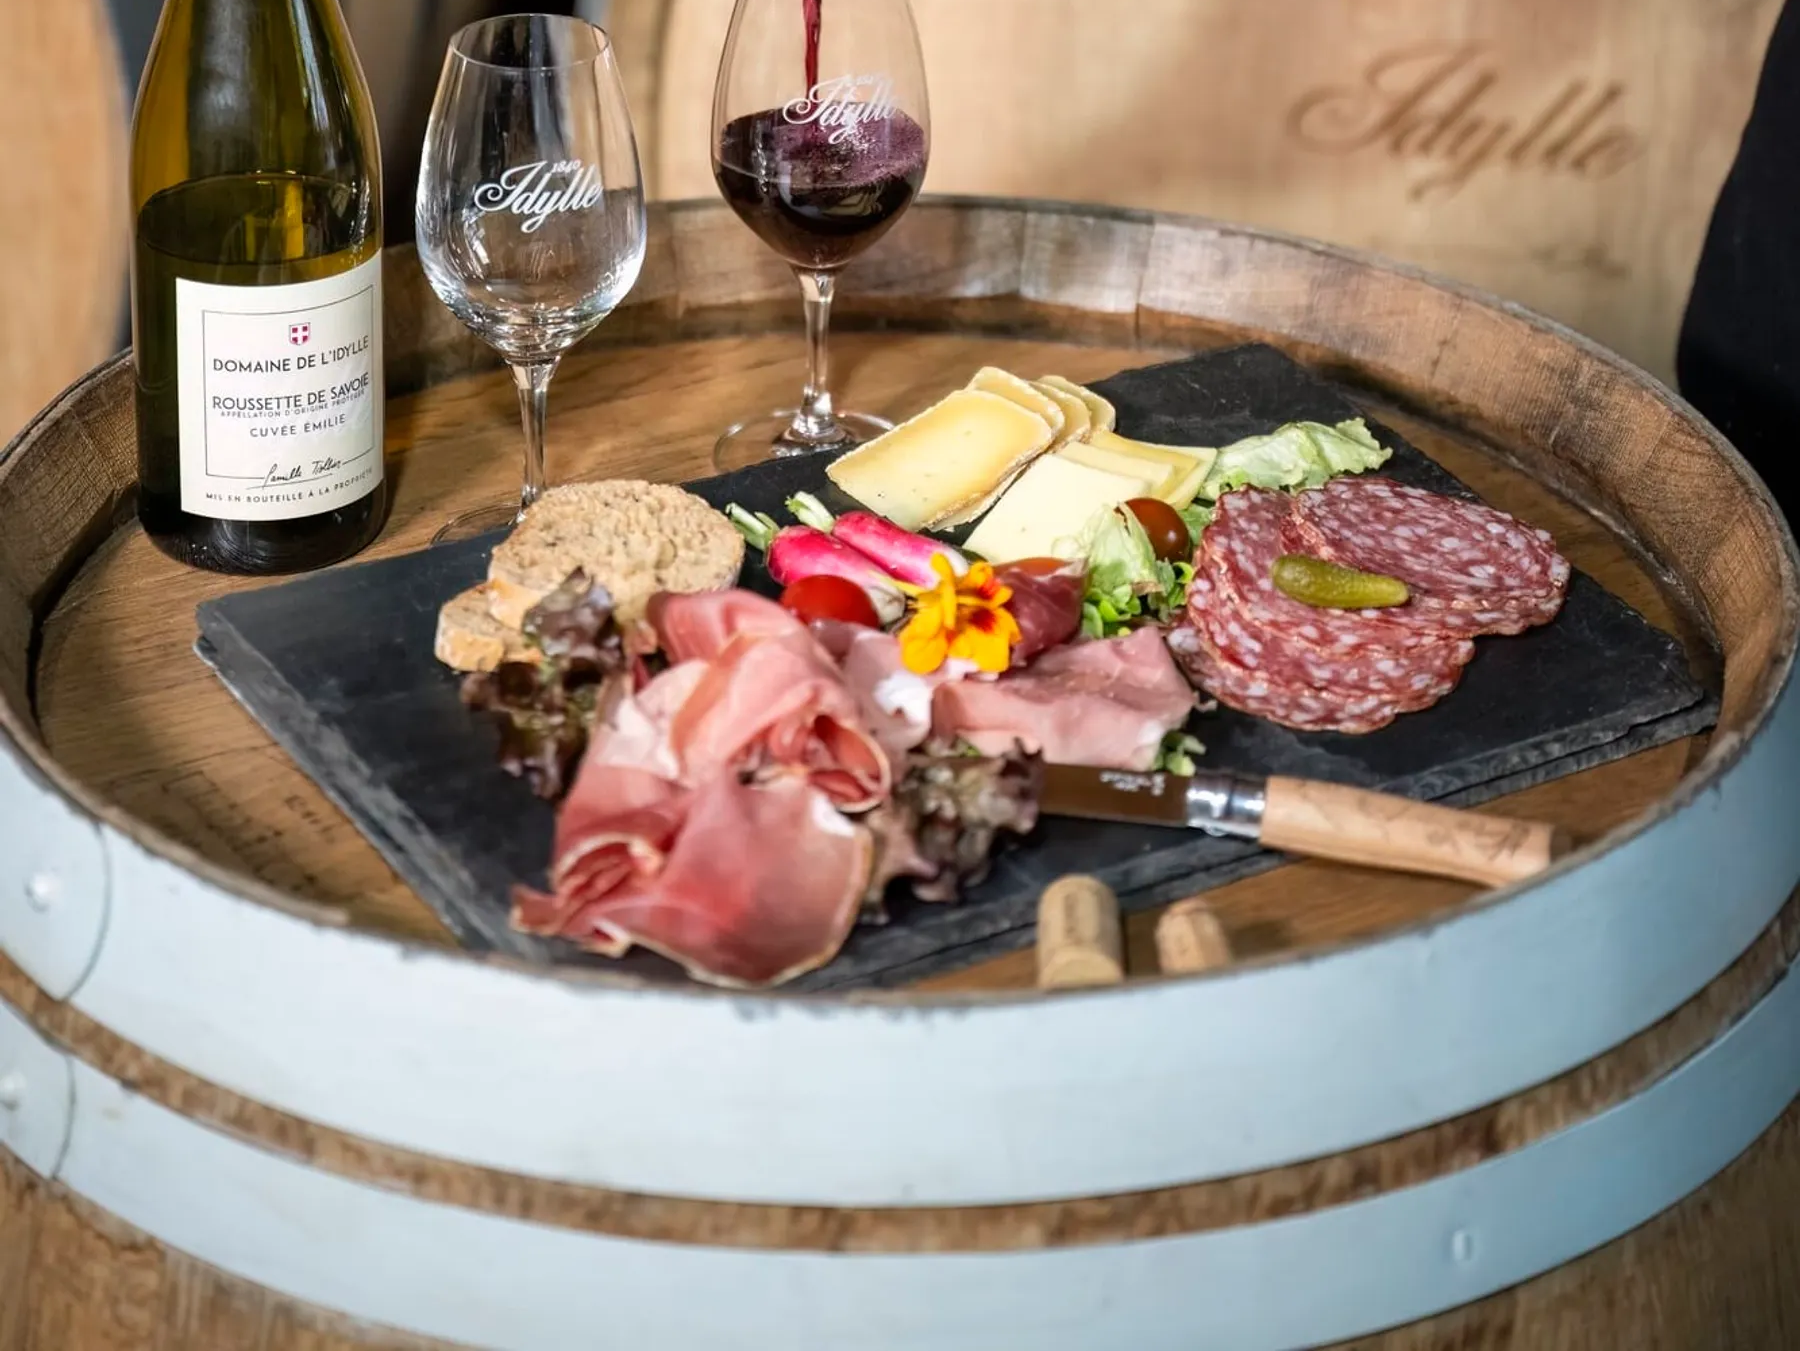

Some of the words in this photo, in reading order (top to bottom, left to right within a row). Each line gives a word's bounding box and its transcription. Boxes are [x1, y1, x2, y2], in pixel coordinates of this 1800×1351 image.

[782, 74, 900, 144] Idylle
[1285, 41, 1646, 204] Idylle
[474, 160, 604, 233] Idylle
[213, 358, 291, 373] DOMAINE
[297, 354, 316, 370] DE
[321, 335, 369, 365] L'IDYLLE
[212, 394, 303, 411] ROUSSETTE
[307, 389, 326, 406] DE
[330, 371, 369, 400] SAVOIE
[220, 410, 281, 418] APPELLATION
[319, 487, 329, 495] LA
